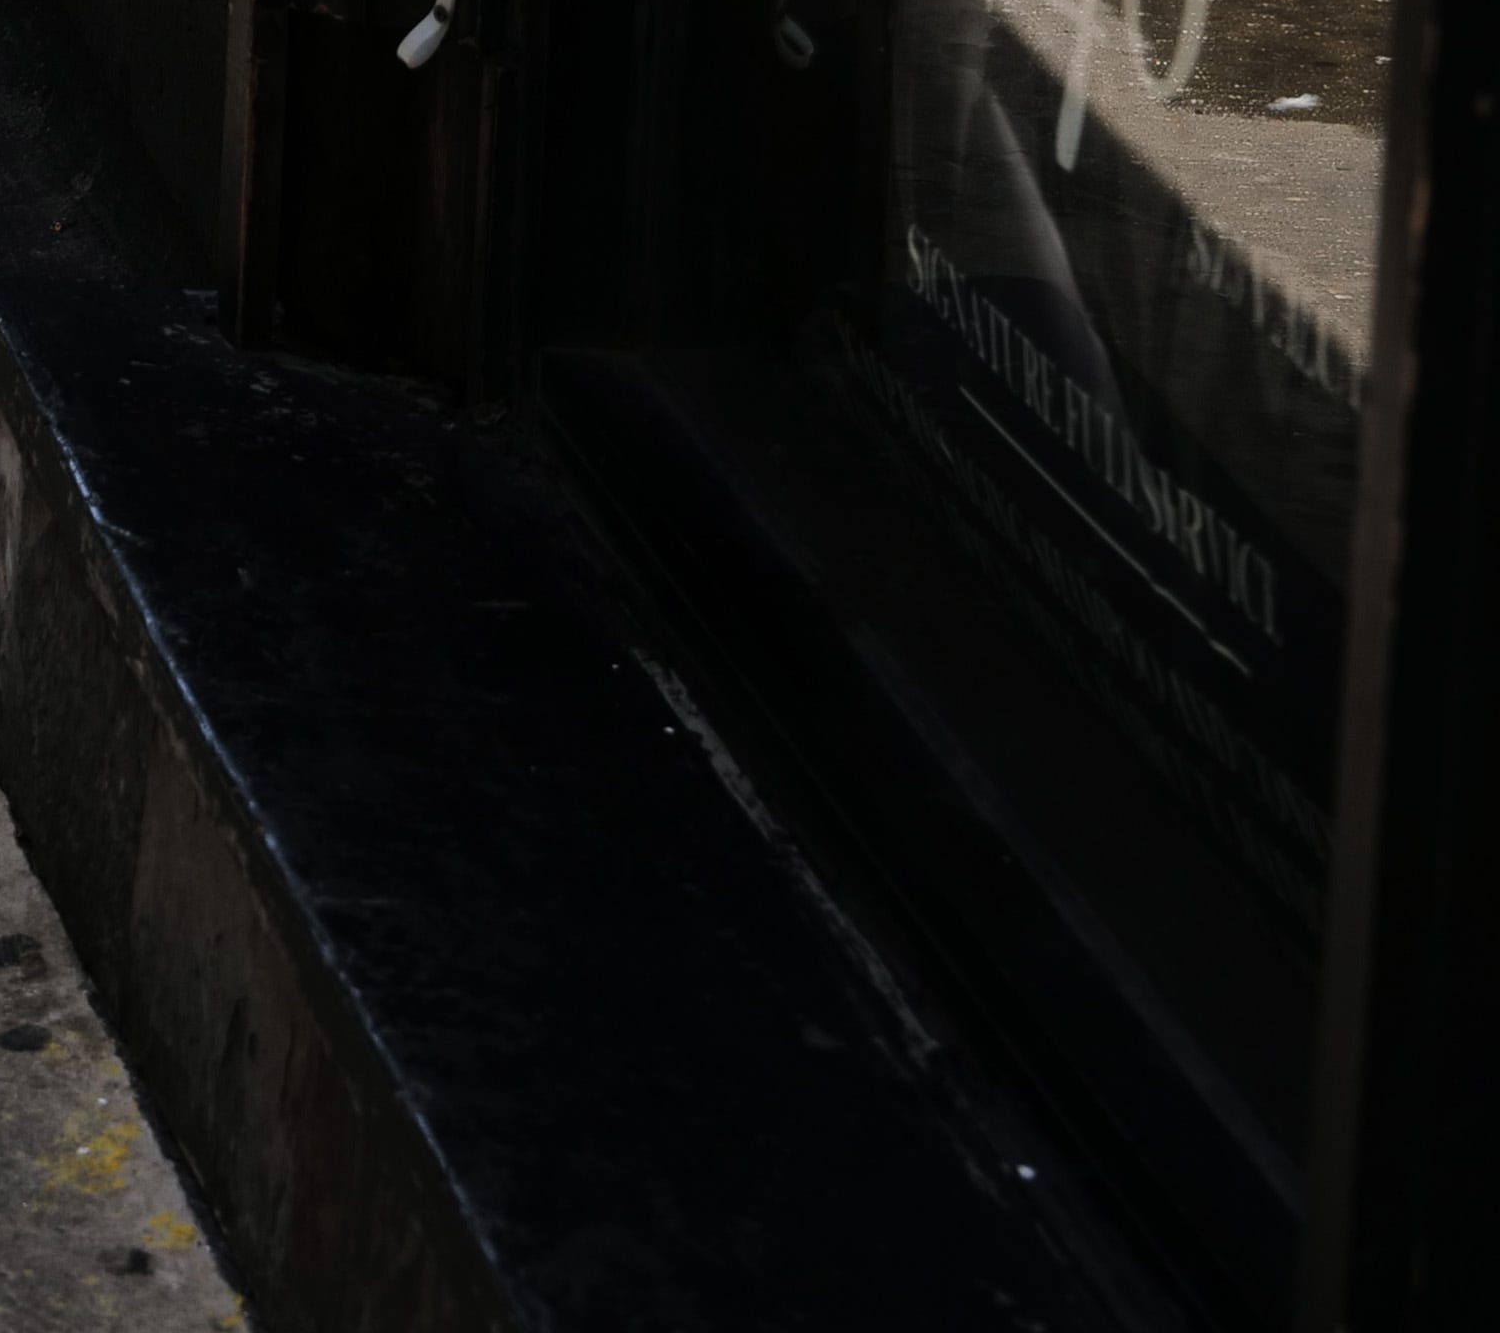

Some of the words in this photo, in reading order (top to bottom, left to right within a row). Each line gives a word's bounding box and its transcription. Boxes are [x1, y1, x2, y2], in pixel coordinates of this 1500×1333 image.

[906, 223, 1060, 435] SIGNATURE
[1064, 376, 1143, 513] FULL
[1134, 443, 1284, 650] SERVICE
